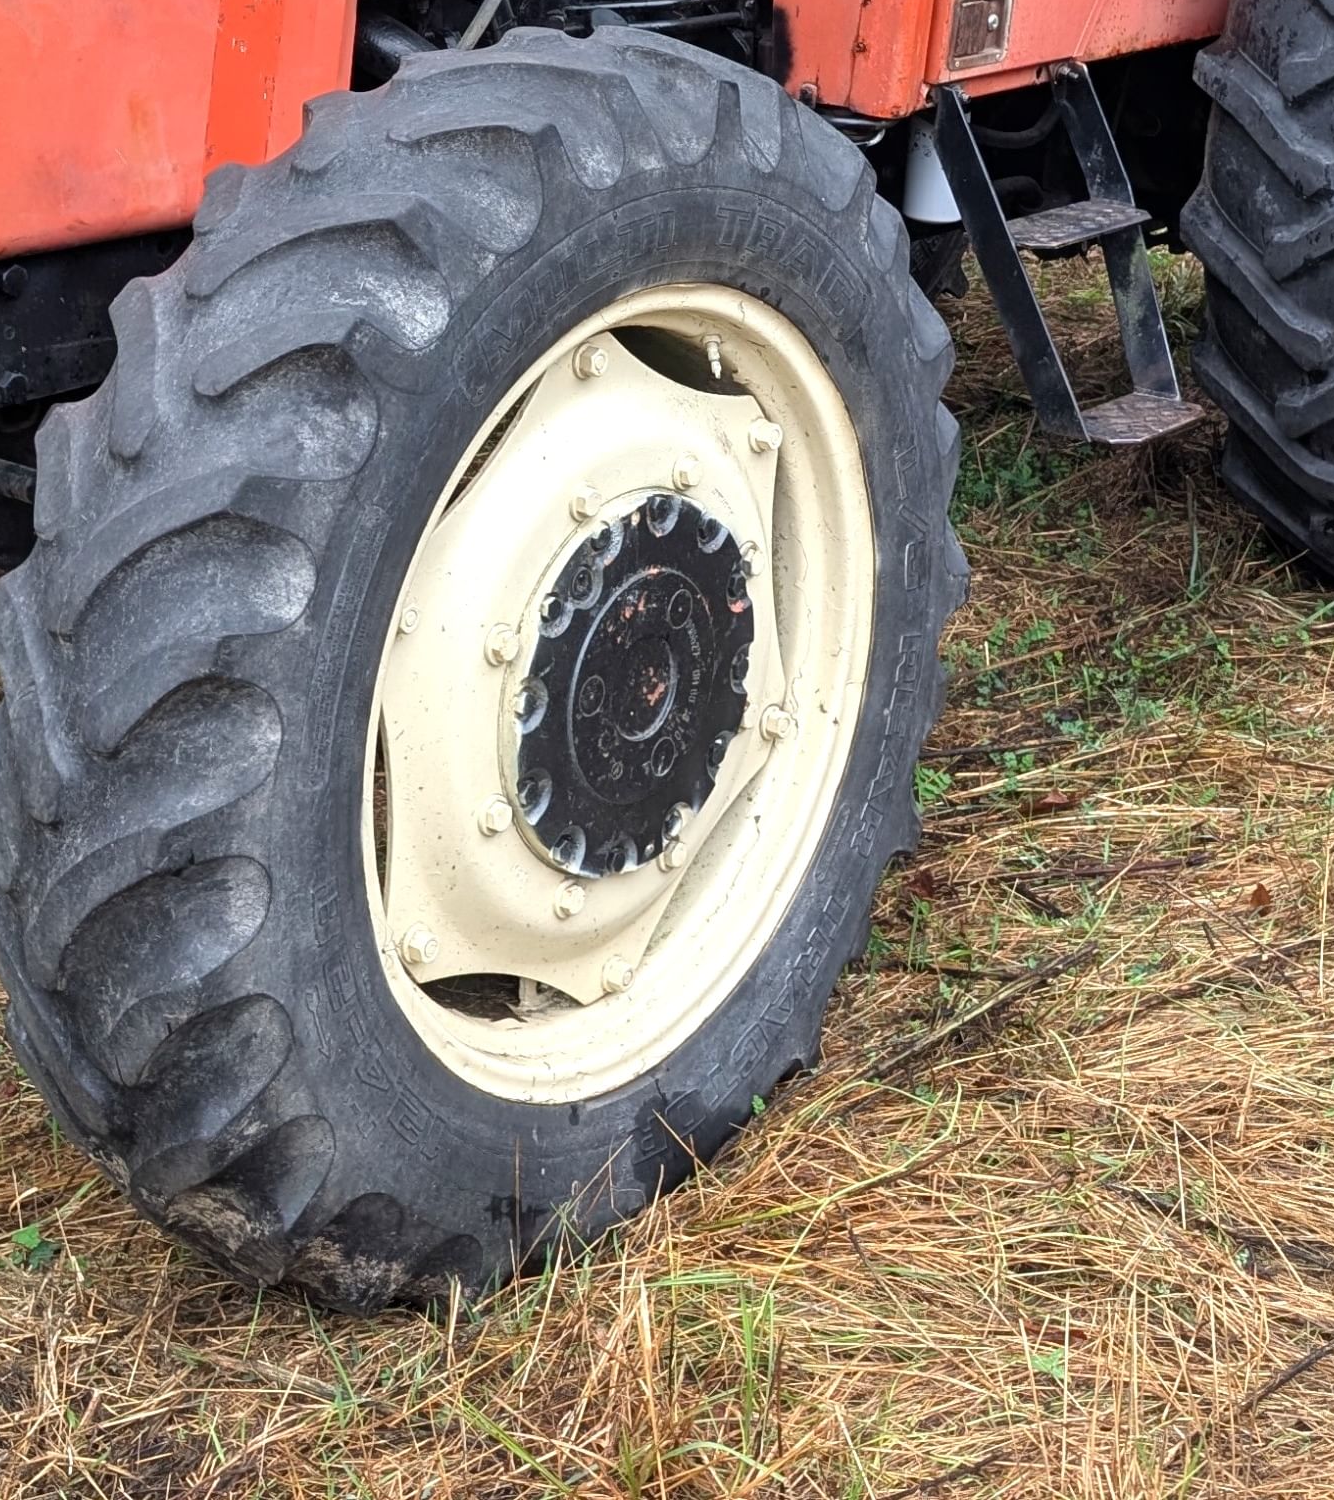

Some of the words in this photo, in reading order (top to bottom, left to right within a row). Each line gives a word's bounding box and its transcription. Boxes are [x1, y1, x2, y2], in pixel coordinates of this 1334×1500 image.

[477, 210, 677, 373] MULTI
[713, 204, 864, 319] TRAC
[849, 633, 923, 859] REAR
[630, 892, 851, 1160] TRACTOR
